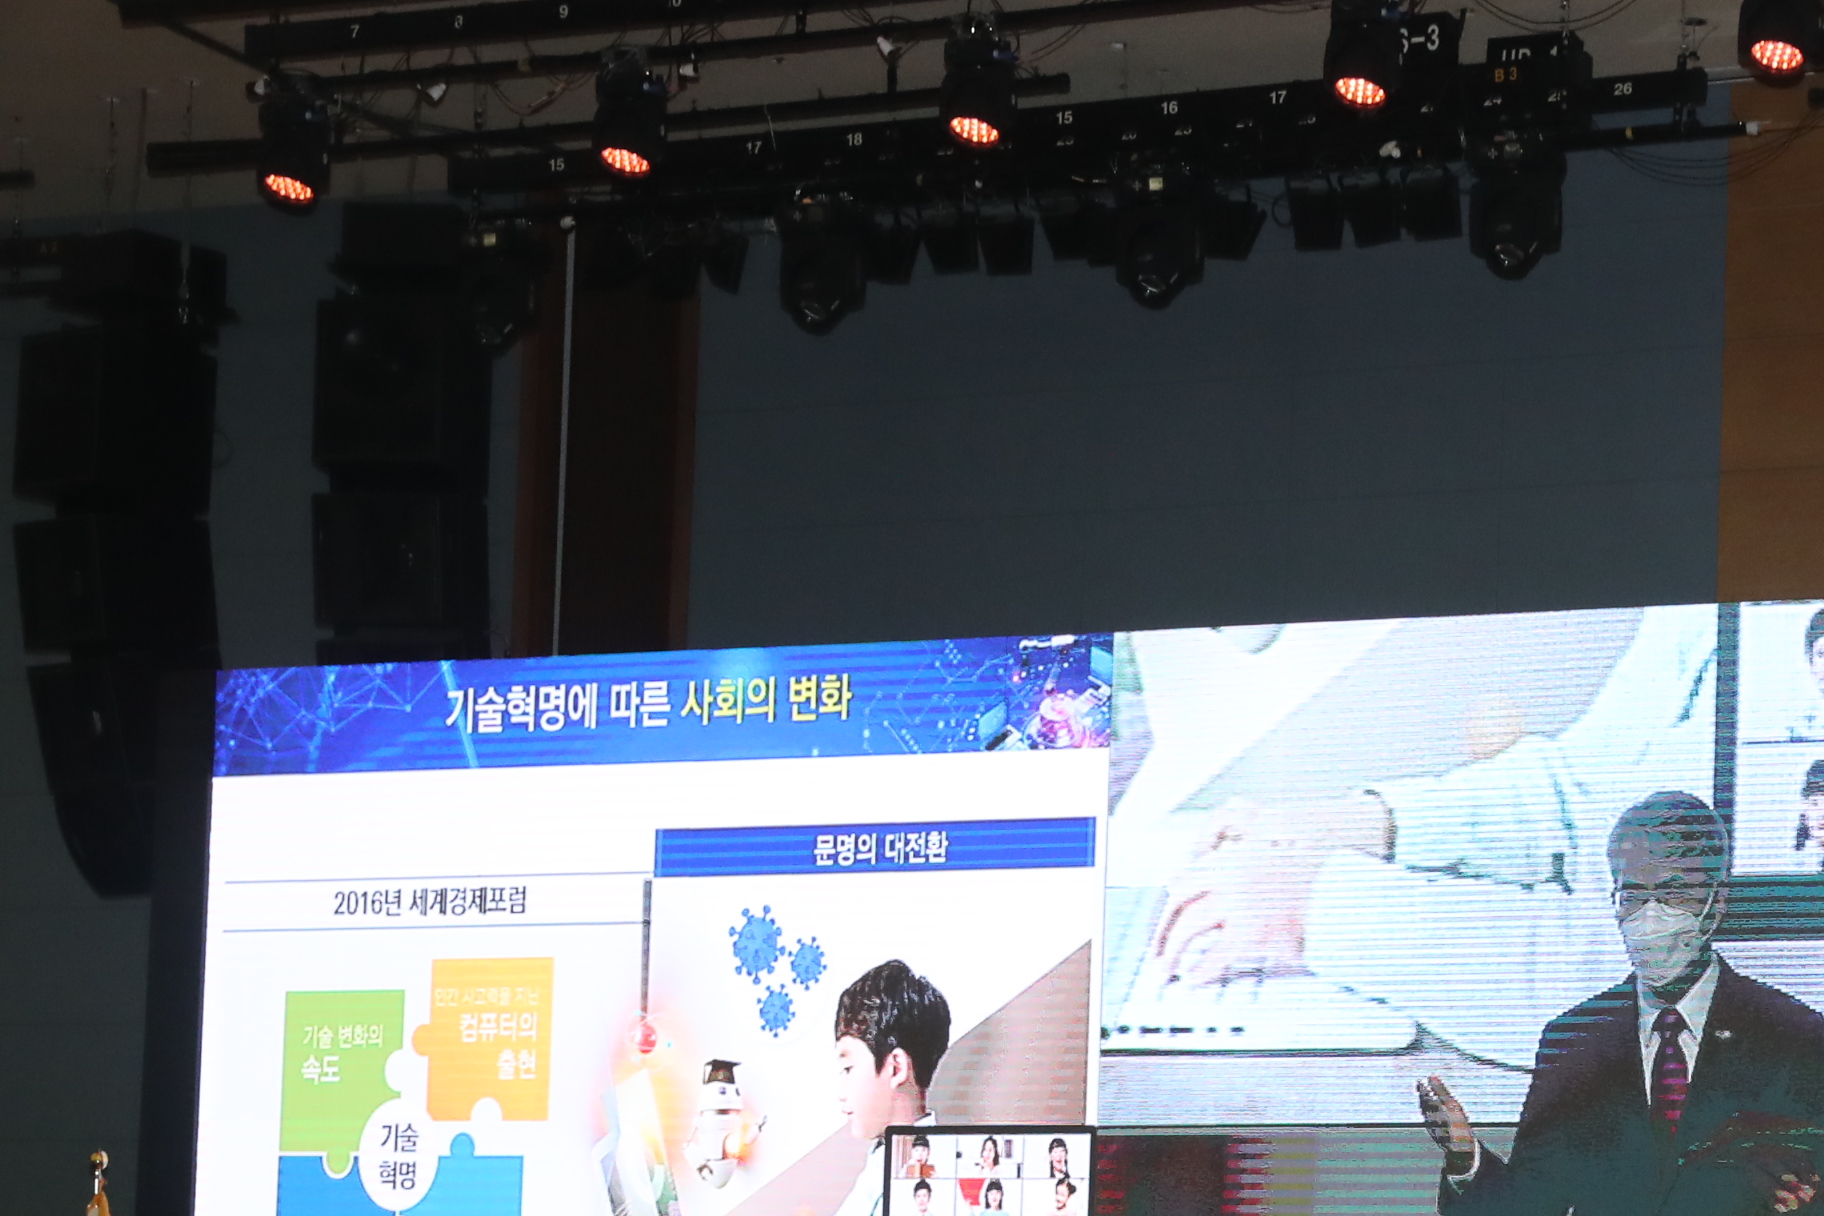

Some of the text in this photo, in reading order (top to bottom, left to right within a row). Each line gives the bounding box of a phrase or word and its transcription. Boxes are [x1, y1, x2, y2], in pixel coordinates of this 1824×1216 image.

[559, 5, 569, 19] 9
[350, 25, 360, 39] 7
[1494, 66, 1518, 83] B 3
[1269, 90, 1287, 105] 17
[1613, 82, 1633, 97] 26
[1161, 101, 1179, 115] 16
[1056, 111, 1074, 126] 15
[846, 132, 863, 147] 18
[745, 141, 763, 156] 17
[548, 157, 566, 172] 15
[445, 672, 854, 735] 기술혁명에 따른 사회의 변화
[813, 830, 949, 867] 문명의 대전환
[333, 885, 527, 917] 2016년 세계경제포럼
[458, 1011, 538, 1043] 컴퓨터의
[302, 1023, 384, 1049] 기술 변화의
[300, 1055, 341, 1085] 속도
[496, 1048, 537, 1081] 출현
[379, 1122, 421, 1154] 기술
[378, 1160, 418, 1191] 혁명
